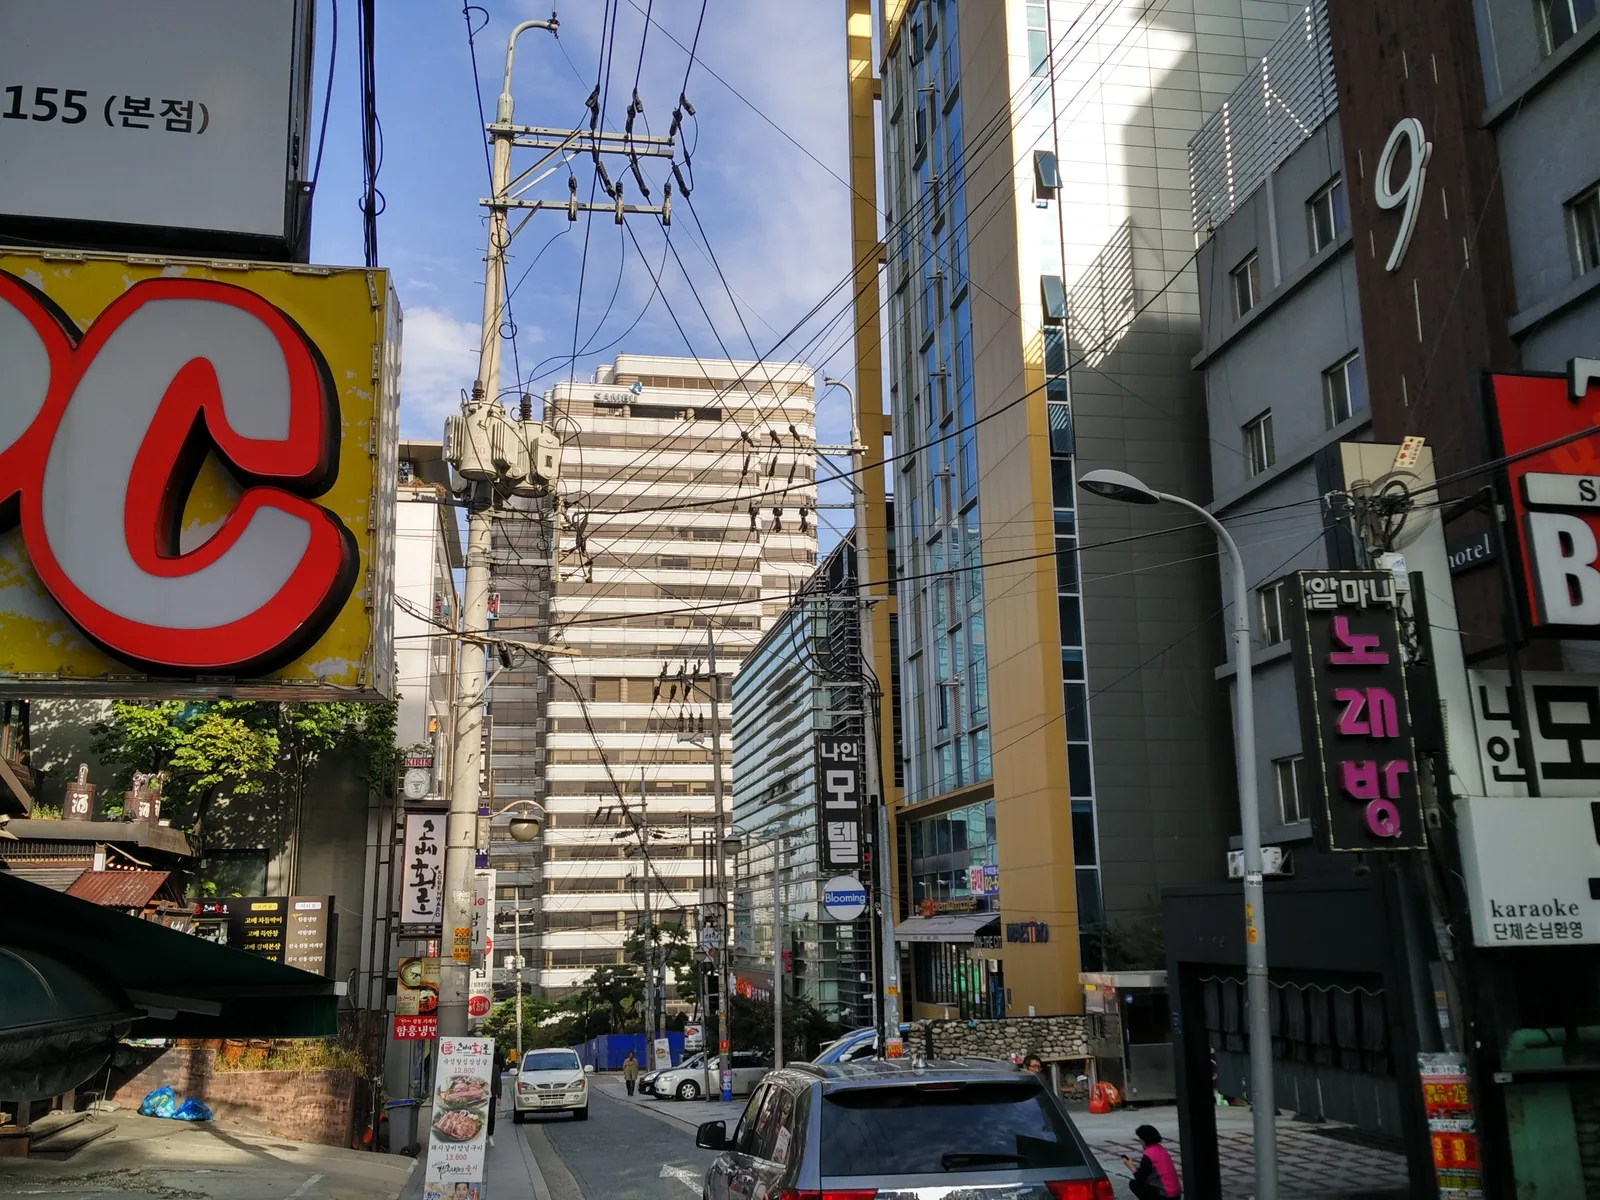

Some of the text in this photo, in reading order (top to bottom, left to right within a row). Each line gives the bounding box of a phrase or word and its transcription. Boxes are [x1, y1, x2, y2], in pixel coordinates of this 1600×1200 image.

[3, 84, 210, 135] 155 (본점)
[1375, 117, 1433, 272] 9
[1305, 576, 1398, 611] 알마니
[404, 758, 433, 767] KIRIN
[821, 742, 858, 761] 나인
[825, 769, 859, 864] 모텔
[434, 869, 443, 918] KOBEHWARO
[824, 891, 866, 904] Blooming
[1490, 899, 1580, 918] karaoke
[1493, 921, 1584, 941] 단체손님환영
